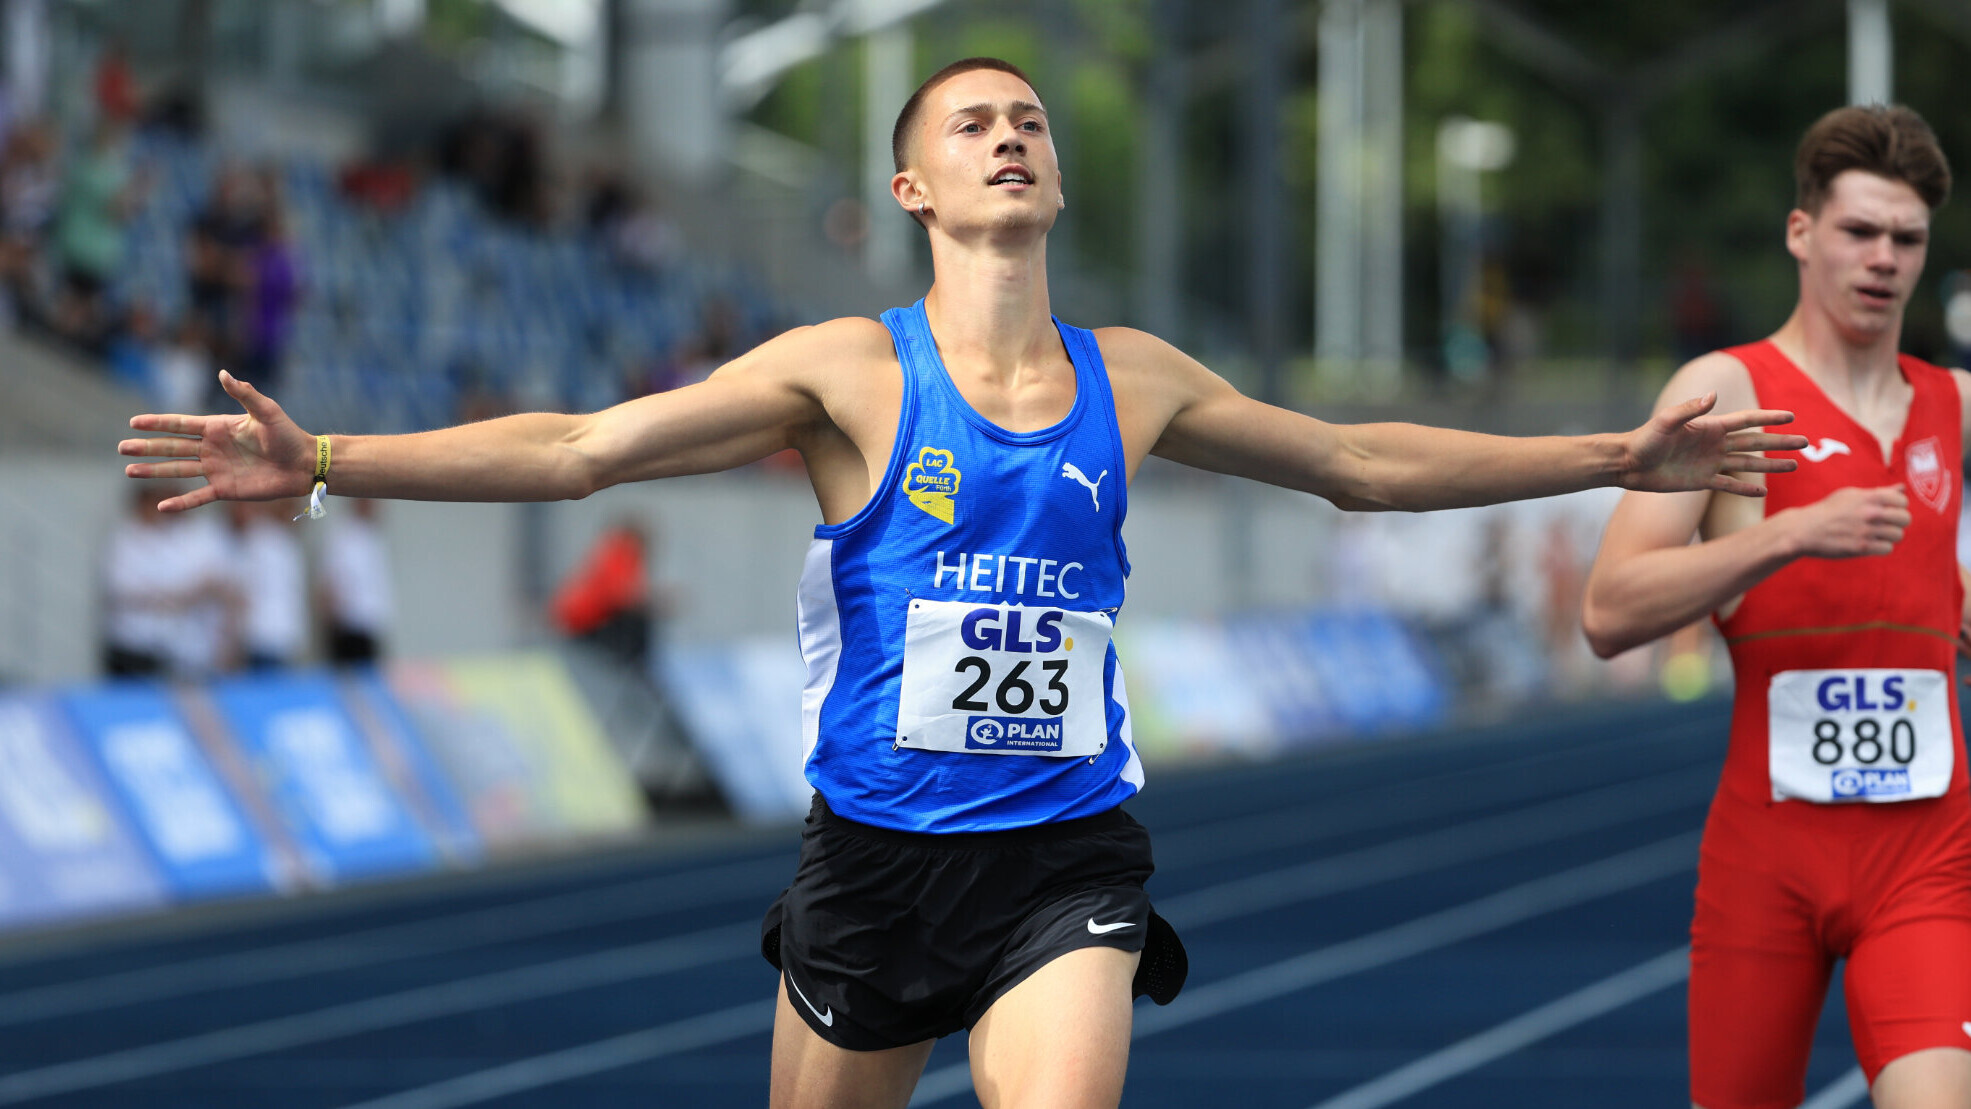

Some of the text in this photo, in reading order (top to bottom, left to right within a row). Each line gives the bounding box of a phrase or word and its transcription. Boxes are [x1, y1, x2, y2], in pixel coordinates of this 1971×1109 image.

[926, 458, 944, 468] LAC
[916, 474, 950, 485] QUELLE
[933, 550, 1084, 599] HEITEC
[952, 655, 1069, 715] 263
[1007, 723, 1060, 739] PLAN
[1812, 718, 1916, 765] 880
[1864, 772, 1908, 787] PLAN
